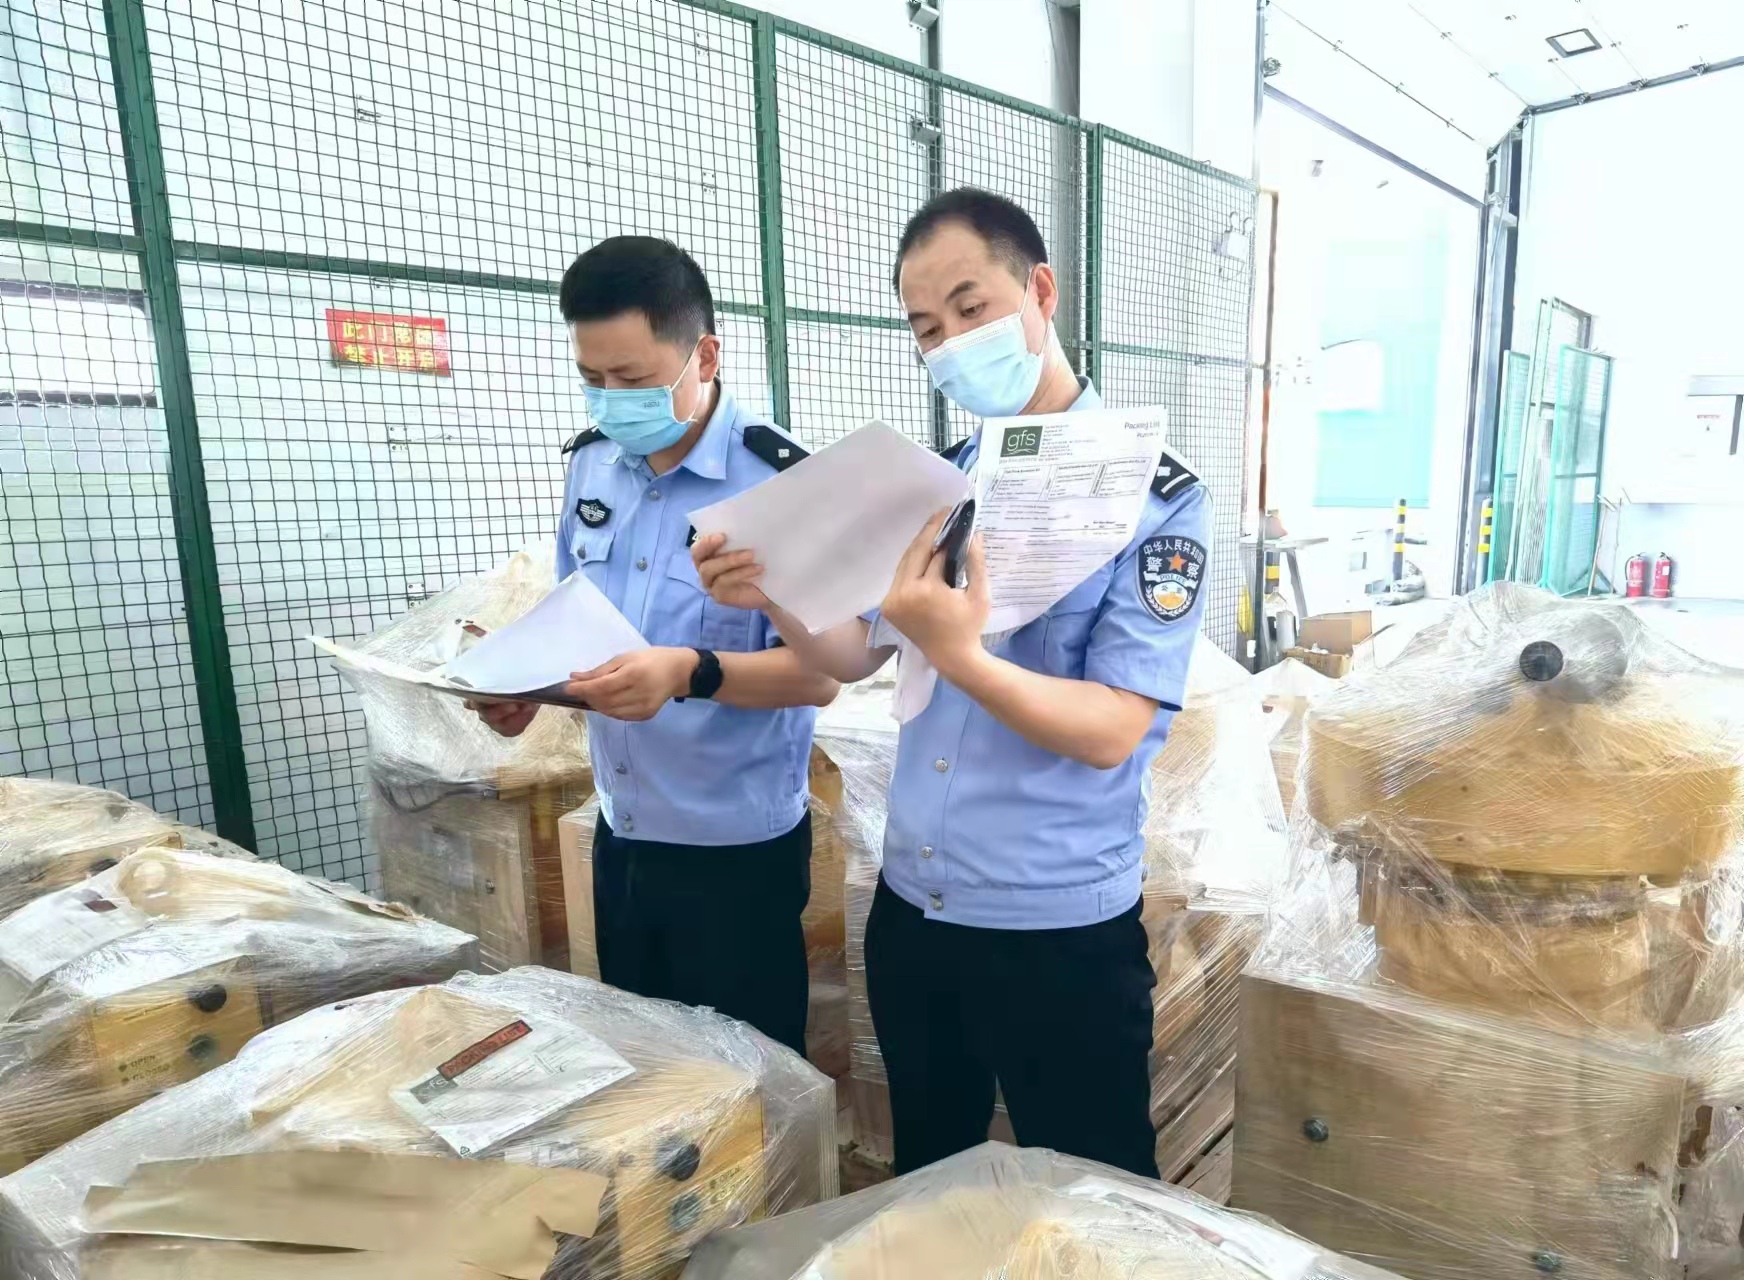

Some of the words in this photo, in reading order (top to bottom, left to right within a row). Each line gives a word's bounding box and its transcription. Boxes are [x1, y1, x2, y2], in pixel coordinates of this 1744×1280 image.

[1007, 430, 1036, 452] gfs
[1144, 539, 1204, 564] 中华人民共和国
[1145, 556, 1163, 572] 警
[1186, 561, 1200, 579] 察
[1159, 574, 1186, 585] POLICE
[130, 1055, 155, 1067] OPEN
